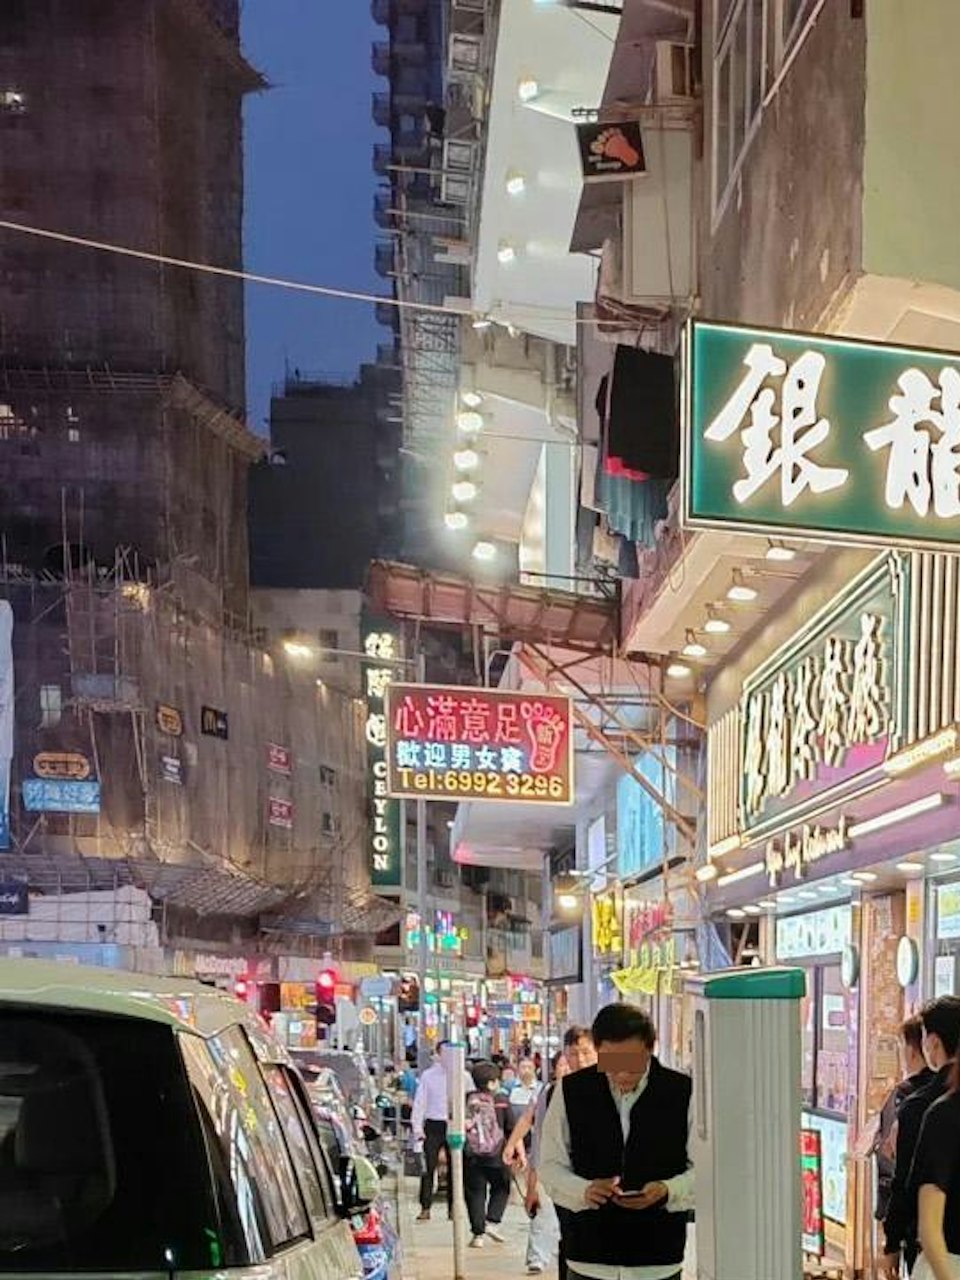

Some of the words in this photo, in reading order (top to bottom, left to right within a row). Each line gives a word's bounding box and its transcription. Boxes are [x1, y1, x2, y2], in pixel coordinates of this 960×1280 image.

[395, 696, 521, 743] 心滿意足
[396, 740, 523, 773] 歡迎男女賓
[397, 767, 501, 794] Tel:6992
[372, 762, 390, 870] CEYLON
